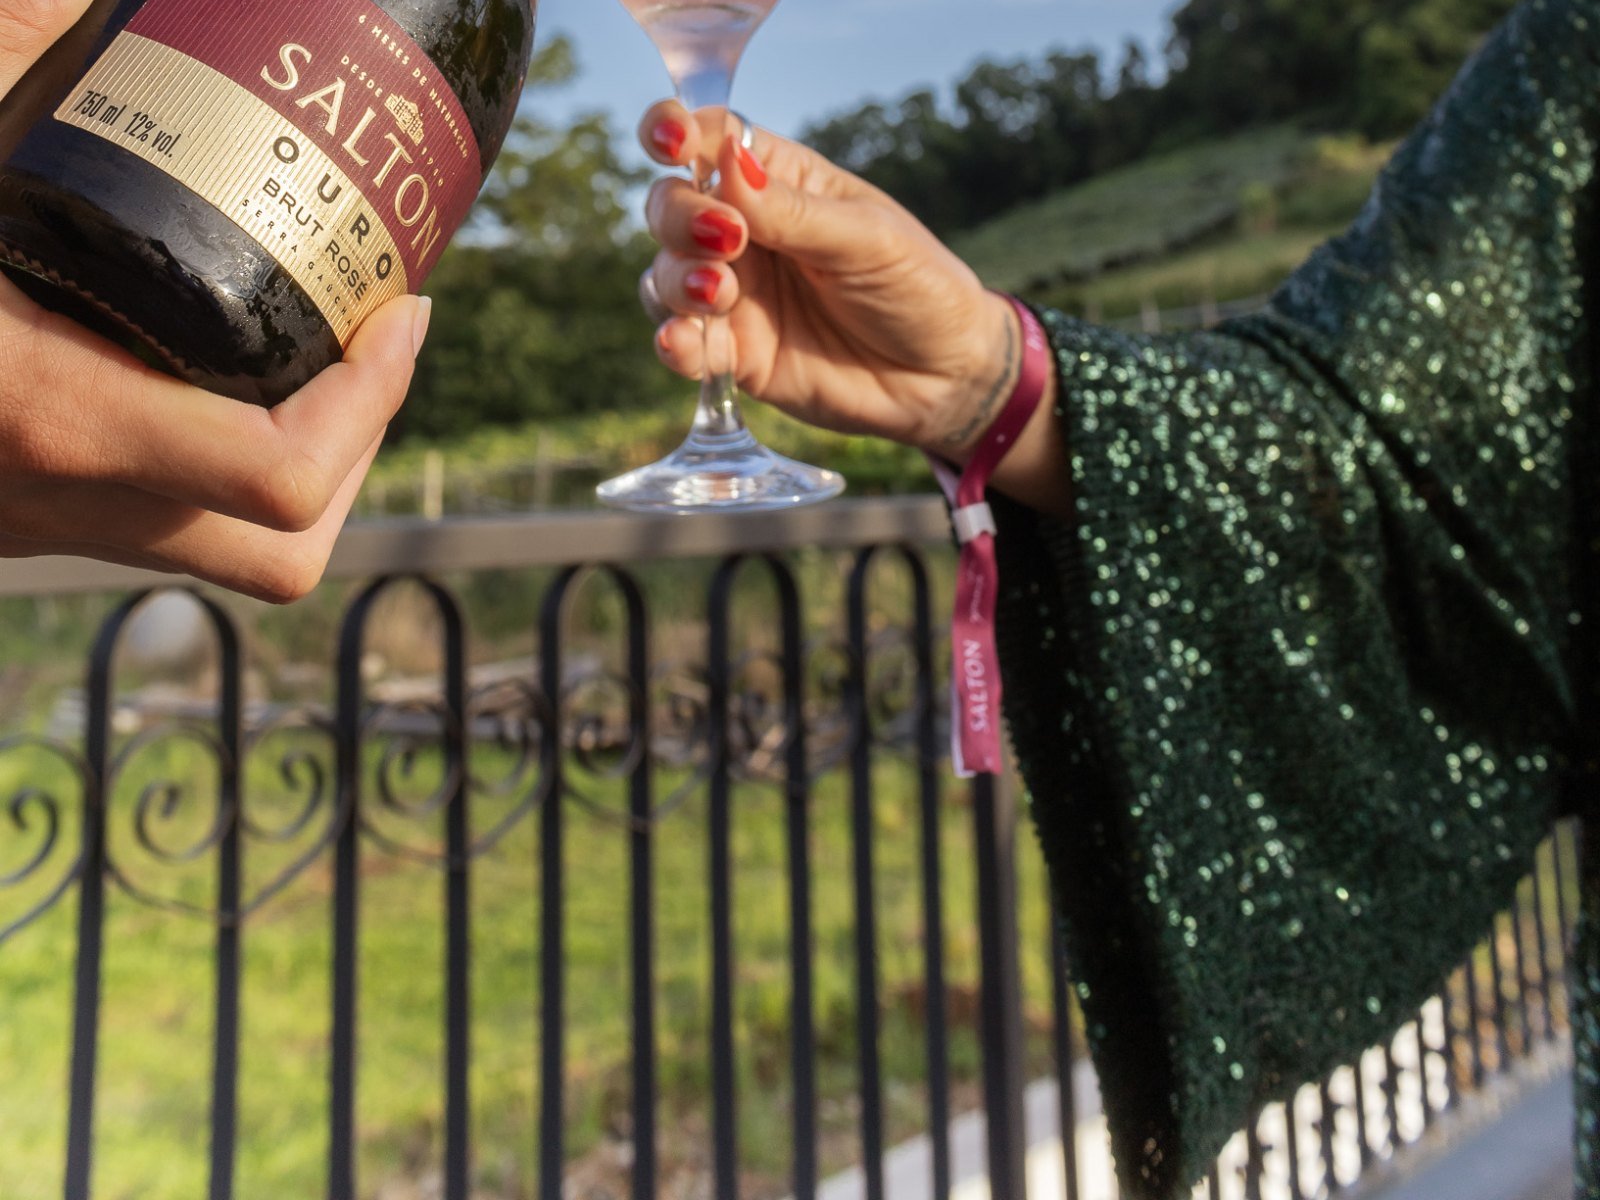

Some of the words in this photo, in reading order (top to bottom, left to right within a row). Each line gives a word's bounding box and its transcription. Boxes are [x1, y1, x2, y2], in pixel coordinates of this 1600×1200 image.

[358, 14, 367, 24] 6
[371, 26, 410, 65] MESES
[412, 67, 427, 86] DE
[74, 90, 108, 118] 750
[99, 104, 127, 126] ml
[124, 112, 157, 142] 12%
[151, 130, 181, 158] vol.
[260, 42, 442, 270] SALTON
[341, 55, 383, 97] DESDE
[421, 147, 444, 187] 1910
[242, 199, 298, 253] SERRA
[262, 177, 324, 237] BRUT
[325, 239, 367, 301] ROSÉ
[273, 136, 392, 280] OURO
[963, 639, 988, 733] SALTON
